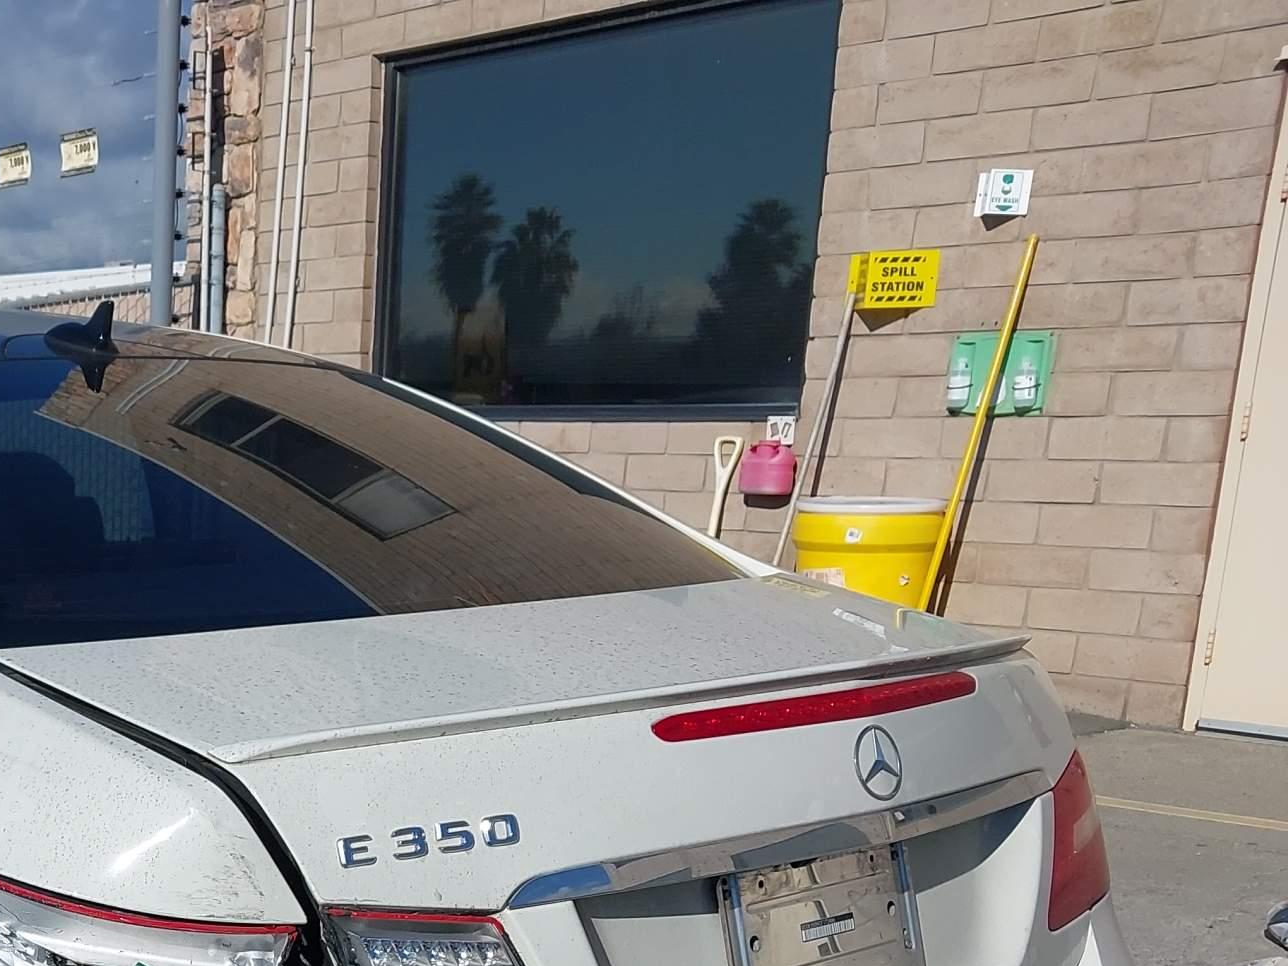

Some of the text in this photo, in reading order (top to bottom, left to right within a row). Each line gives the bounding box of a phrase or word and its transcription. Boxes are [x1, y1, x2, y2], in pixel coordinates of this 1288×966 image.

[881, 266, 917, 278] SPILL
[871, 280, 925, 293] STATION
[336, 813, 521, 869] E 350
